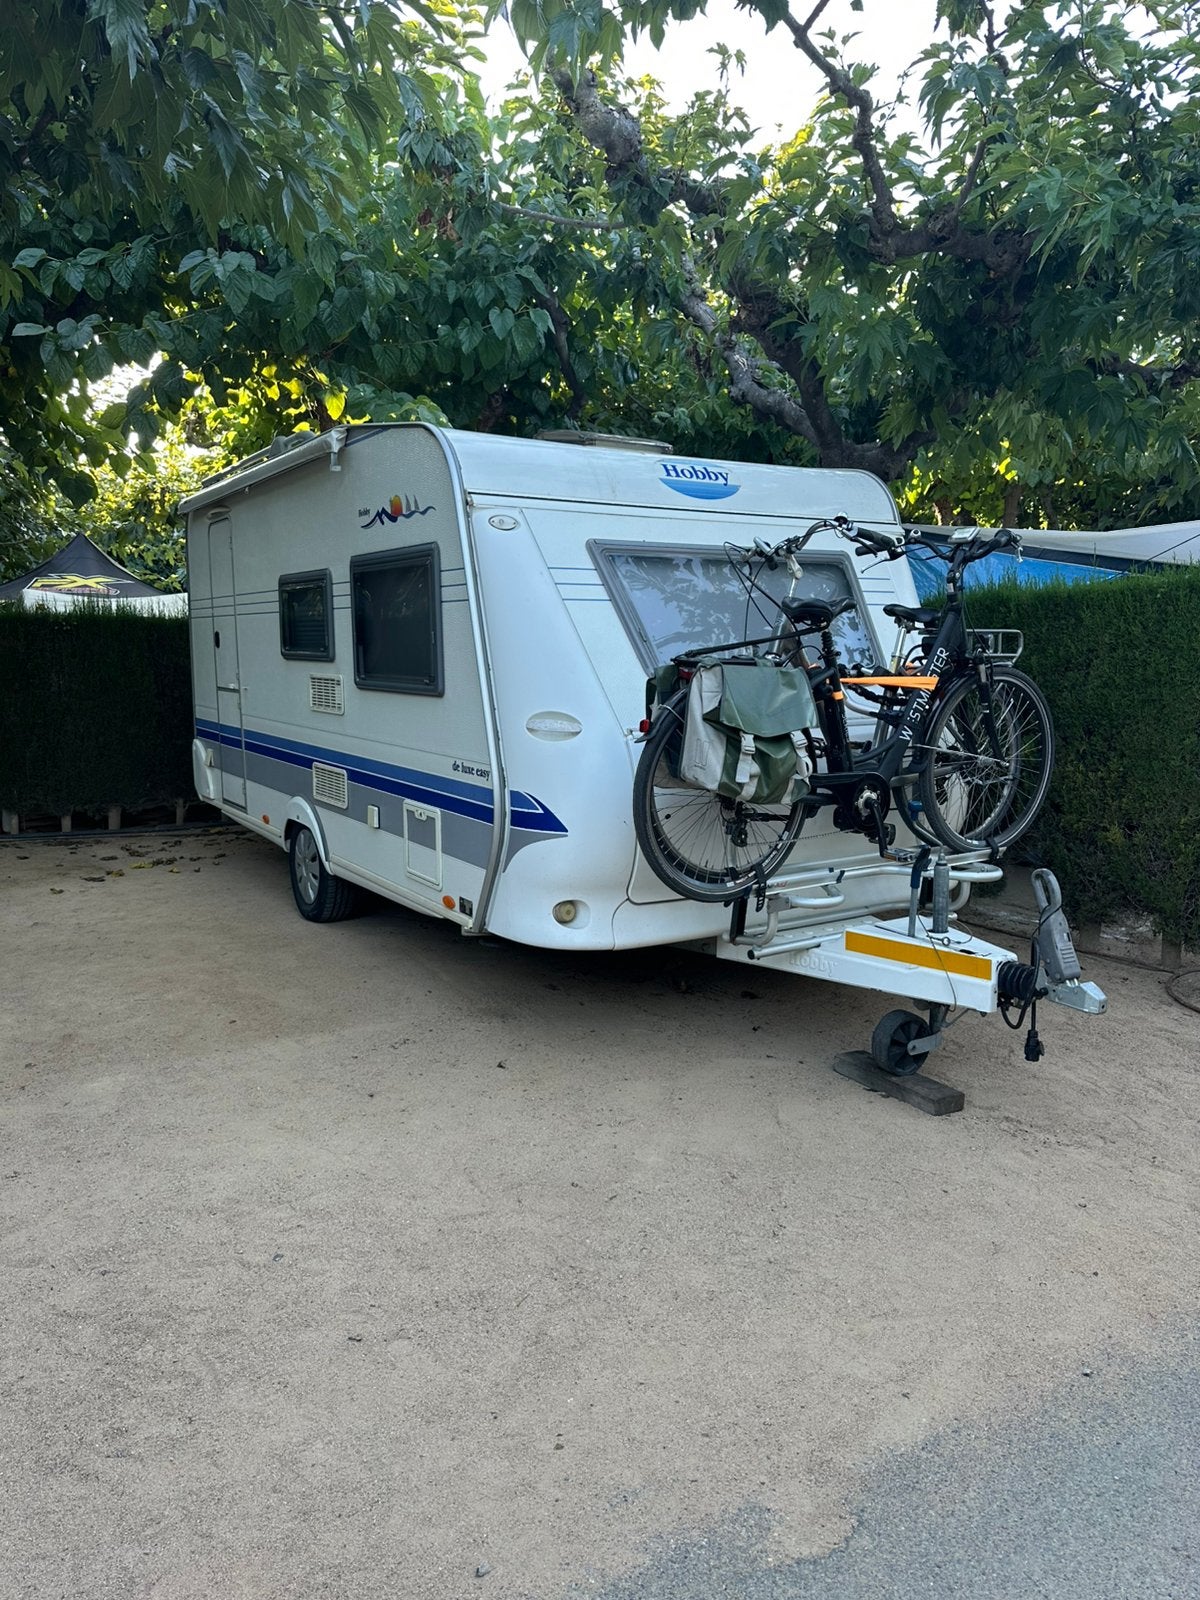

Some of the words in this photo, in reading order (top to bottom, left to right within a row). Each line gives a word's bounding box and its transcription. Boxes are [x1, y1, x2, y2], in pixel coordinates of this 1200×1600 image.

[660, 463, 729, 487] Hobby
[452, 760, 460, 772] de
[461, 762, 475, 776] luxe
[476, 768, 490, 781] easy
